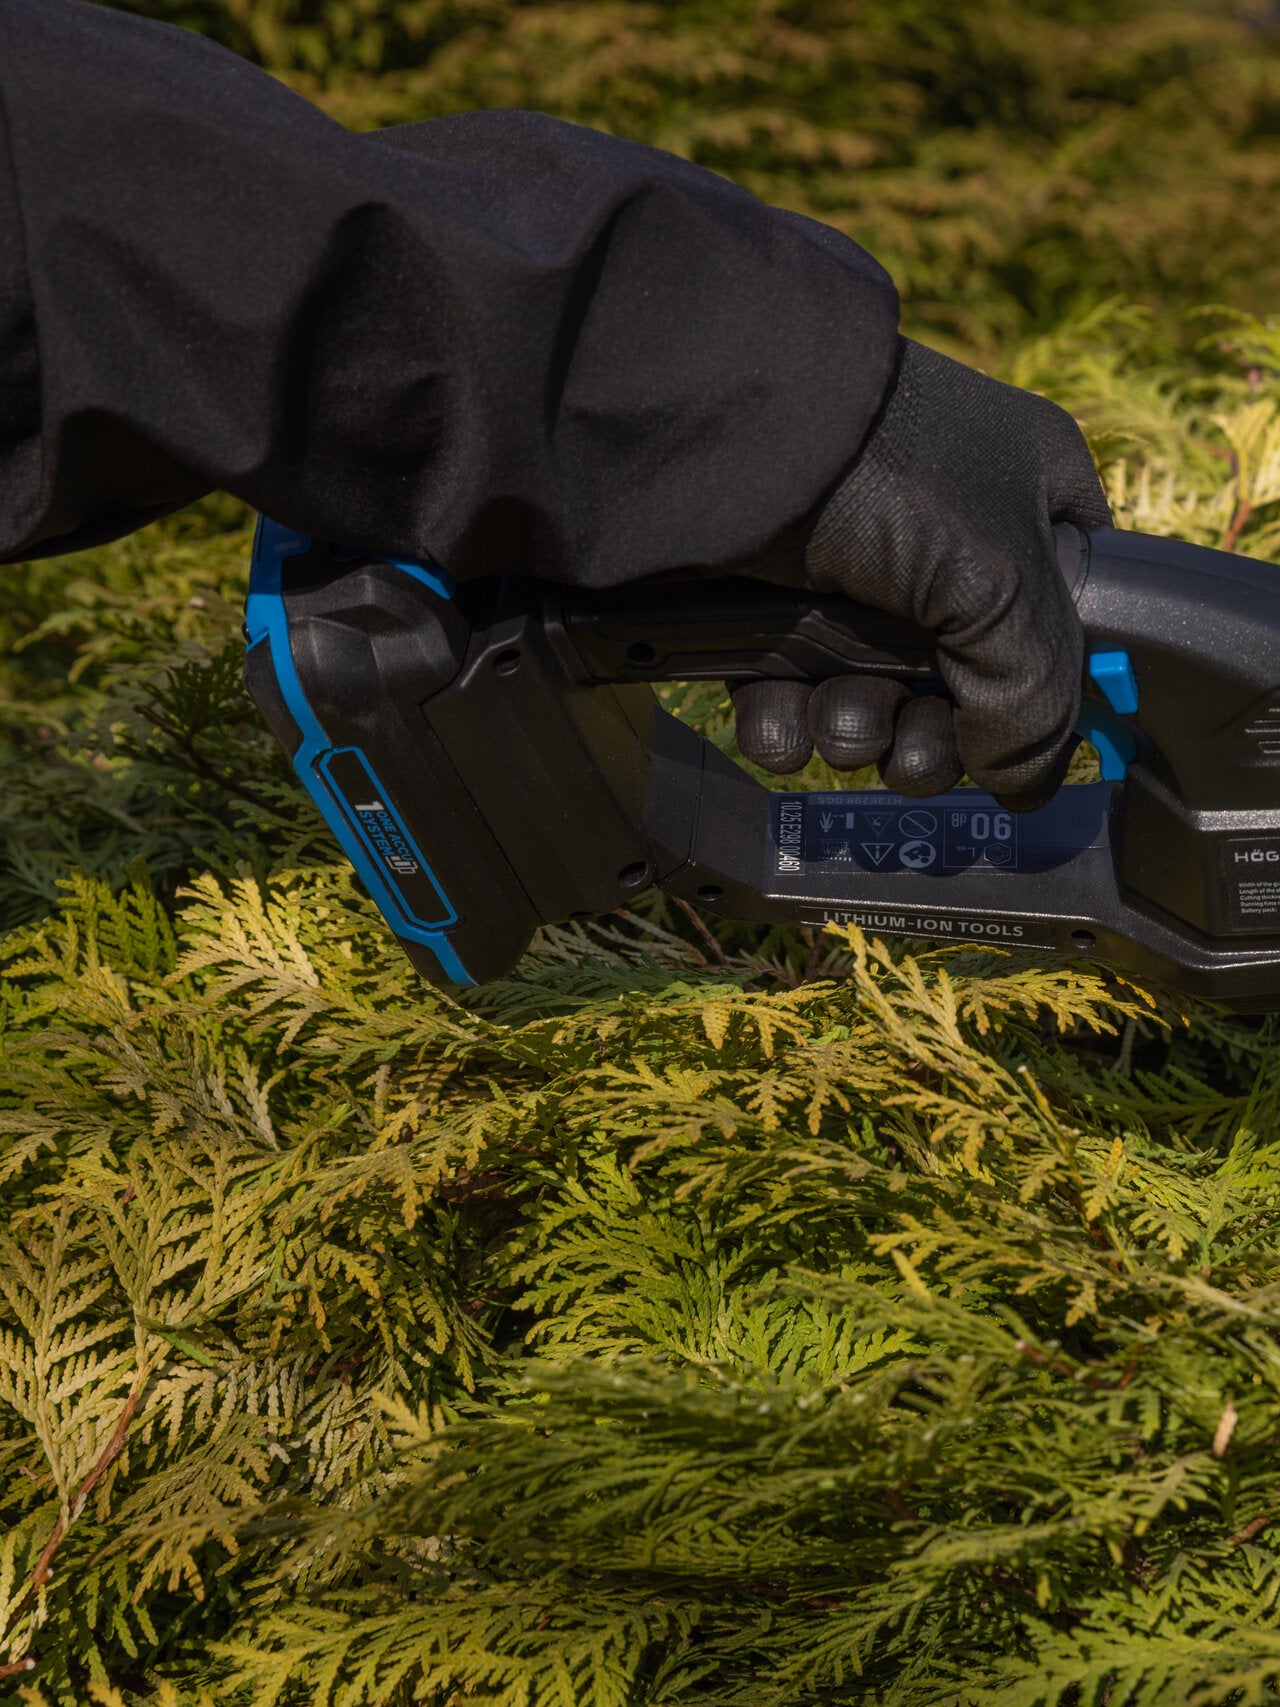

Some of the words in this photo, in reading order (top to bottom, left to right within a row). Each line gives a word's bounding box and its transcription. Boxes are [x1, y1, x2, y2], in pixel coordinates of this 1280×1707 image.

[355, 801, 384, 811] 1
[780, 801, 802, 822] 10.25
[951, 812, 967, 827] dB
[971, 813, 1011, 840] 90
[359, 811, 395, 857] SYSTEM
[376, 811, 396, 832] ONE
[389, 834, 414, 861] ACCU
[780, 824, 801, 844] E298
[778, 845, 800, 871] 00460
[823, 911, 953, 932] LITHIUM-ION
[958, 921, 1024, 937] TOOLS
